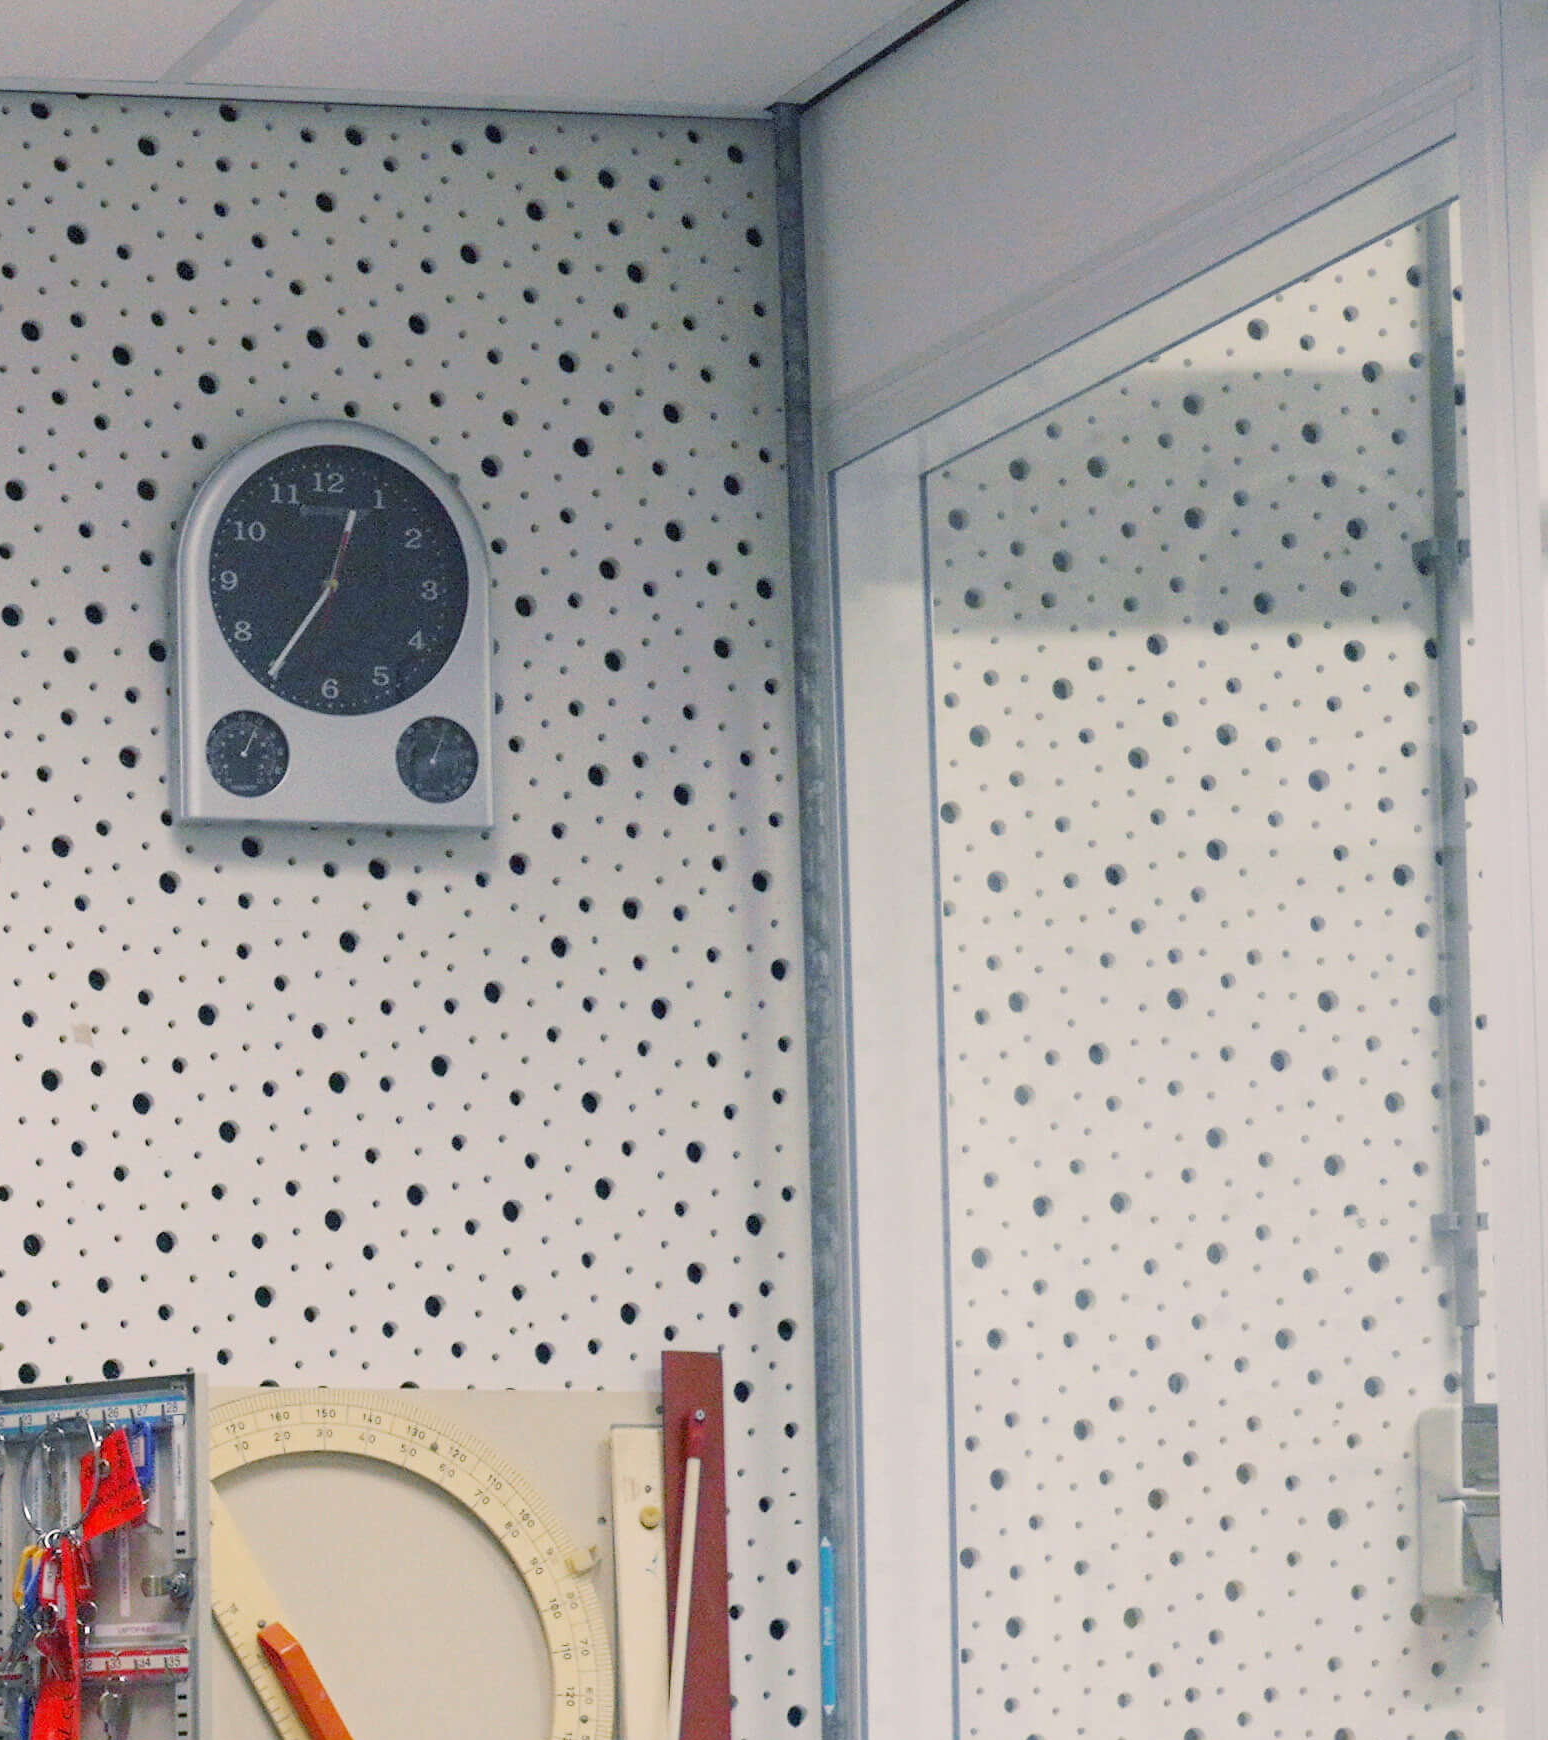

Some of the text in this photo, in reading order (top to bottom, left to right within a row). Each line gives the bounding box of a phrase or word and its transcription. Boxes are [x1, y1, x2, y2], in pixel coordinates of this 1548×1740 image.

[313, 472, 344, 494] 12
[272, 484, 300, 503] 11
[373, 490, 385, 509] 1
[234, 522, 265, 541] 10
[405, 529, 422, 548] 2
[221, 572, 238, 590] 9
[422, 581, 438, 600] 3
[234, 622, 252, 641] 8
[409, 631, 423, 650] 4
[373, 667, 389, 686] 5
[322, 679, 339, 698] 6
